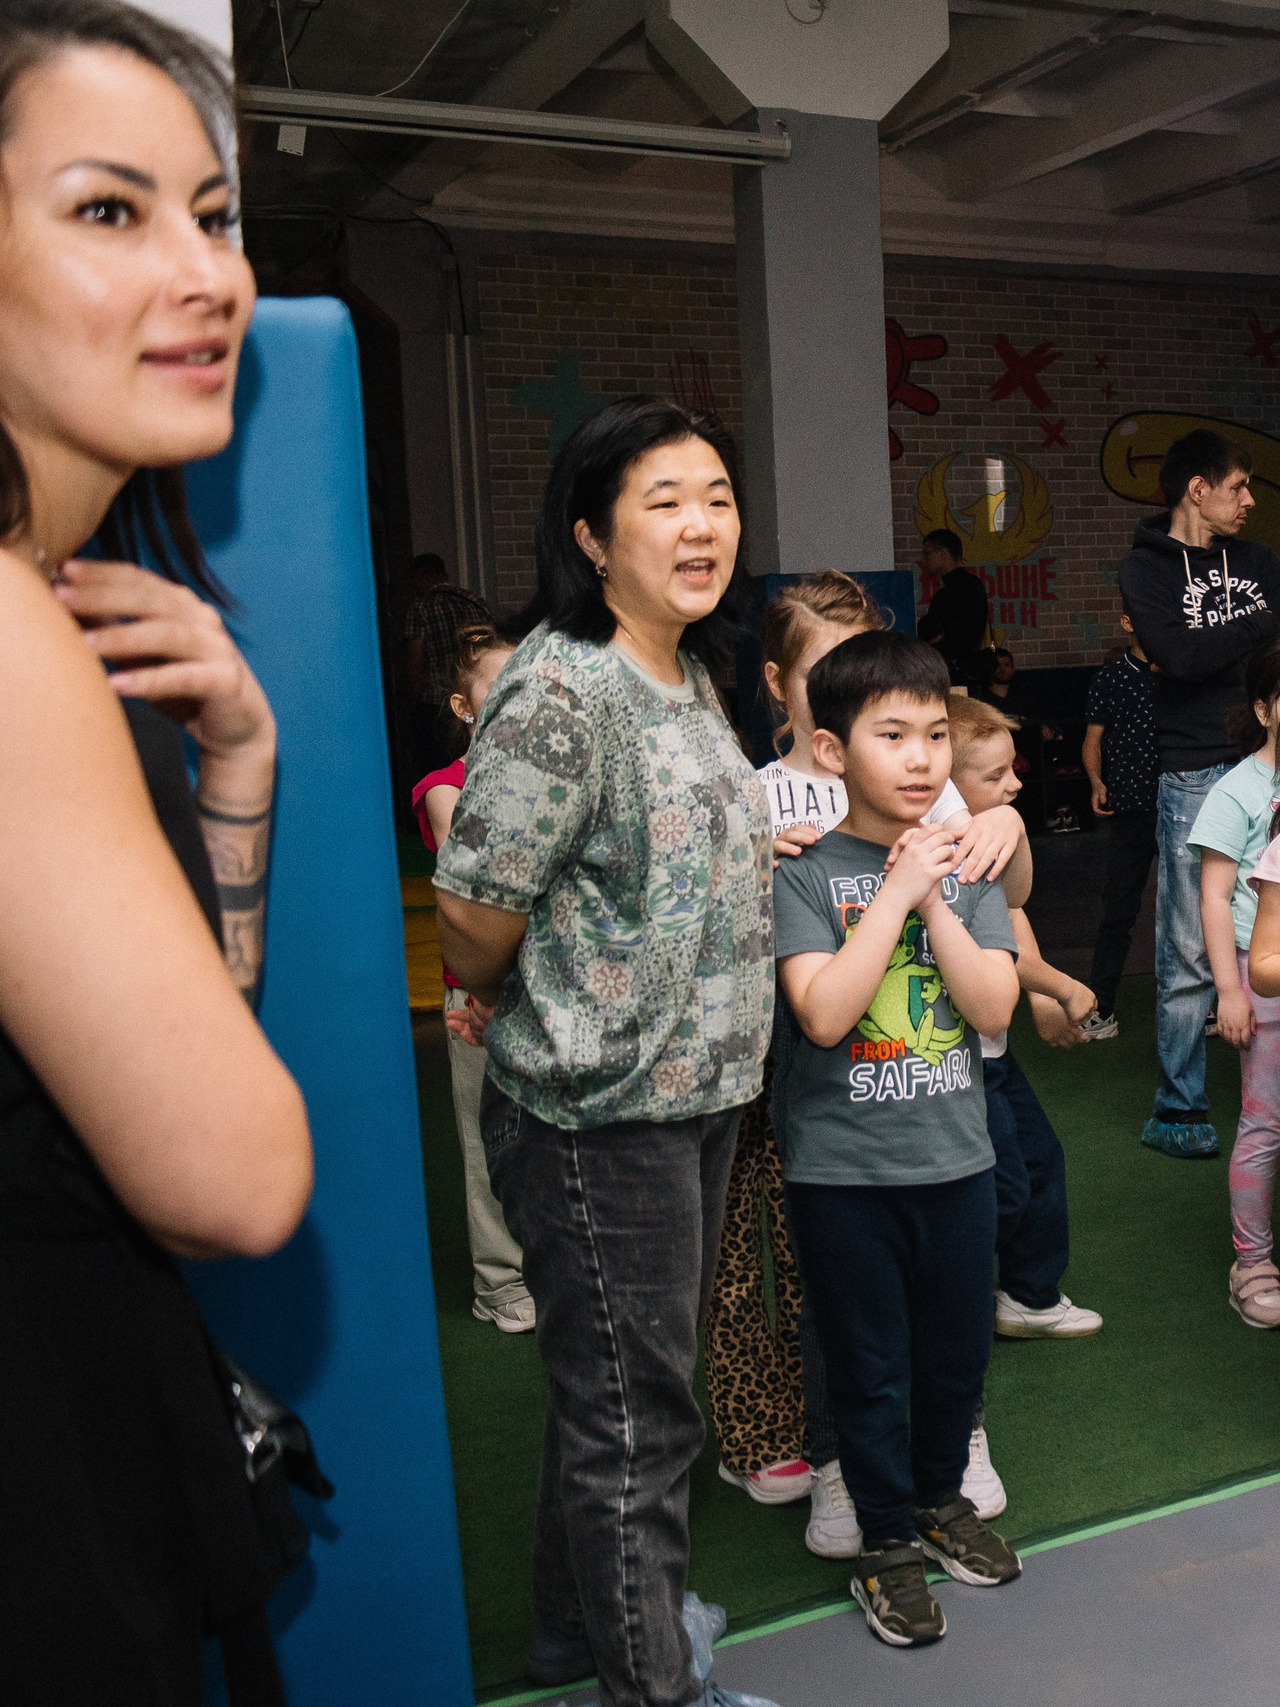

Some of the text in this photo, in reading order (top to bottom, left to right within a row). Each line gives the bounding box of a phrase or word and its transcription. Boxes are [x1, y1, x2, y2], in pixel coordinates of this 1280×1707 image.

[830, 872, 960, 908] FRD
[850, 1037, 906, 1062] FROM
[849, 1048, 972, 1102] SAFARI
